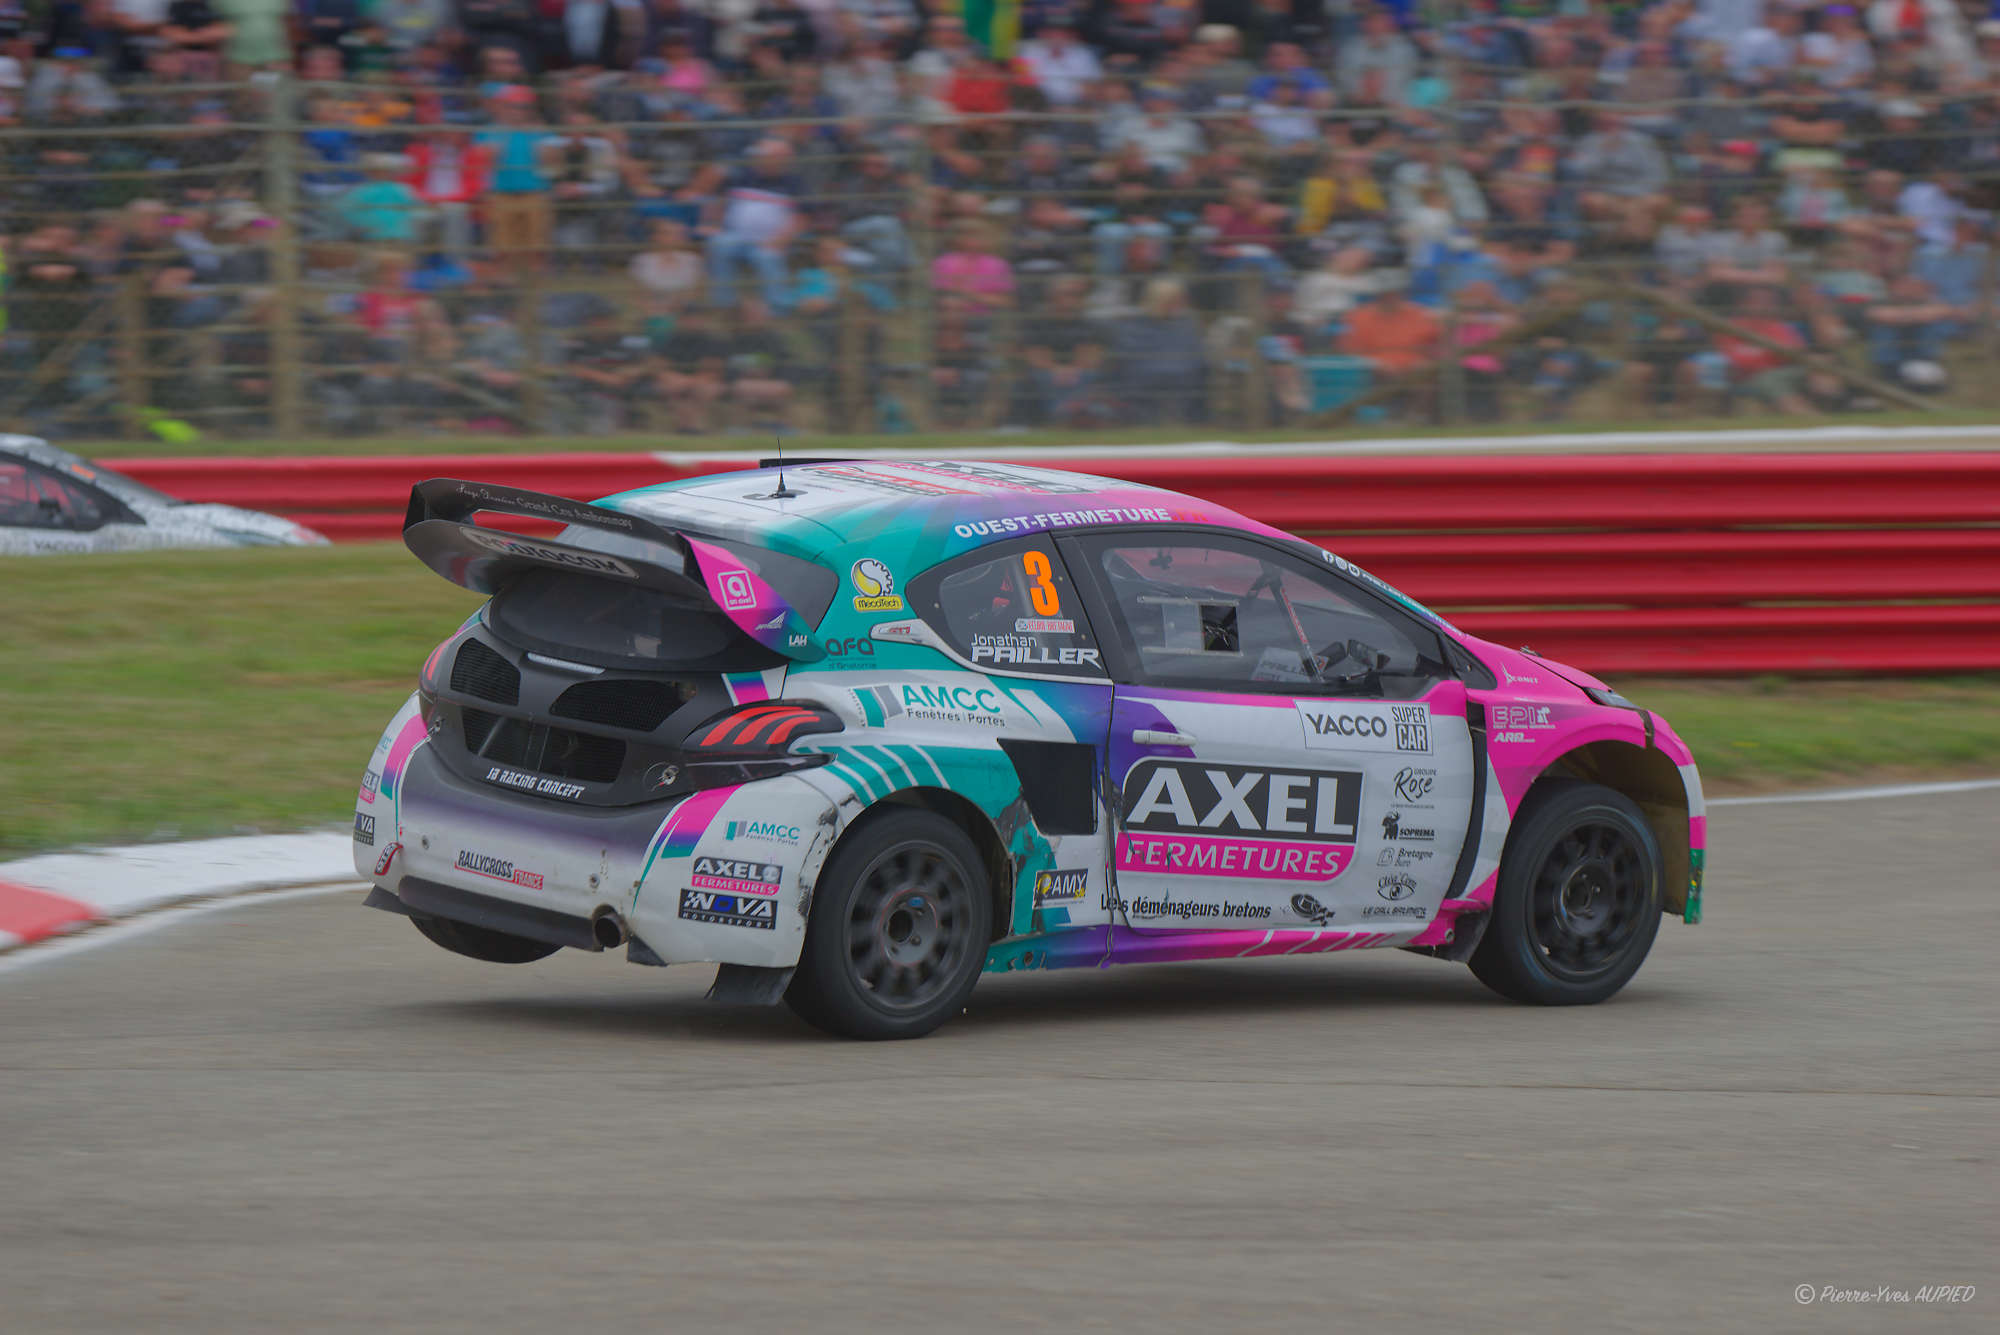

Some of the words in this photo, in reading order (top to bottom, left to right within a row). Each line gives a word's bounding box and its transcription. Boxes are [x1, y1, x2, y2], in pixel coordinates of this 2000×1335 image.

[1023, 550, 1060, 616] 3
[825, 637, 874, 656] afa
[971, 633, 1037, 648] Jonathan
[971, 647, 1102, 670] PAILLER
[902, 685, 1001, 714] AMCC
[968, 713, 1005, 727] Portes
[1306, 713, 1387, 738] YACCO
[1392, 706, 1426, 723] SUPER
[1396, 725, 1428, 751] CAR
[500, 770, 537, 790] RACING
[537, 779, 585, 799] CONCEPT
[1126, 767, 1355, 836] AXEL
[749, 821, 800, 840] AMCC
[458, 850, 513, 878] RALLYCROSS
[695, 858, 761, 880] AXEL
[1126, 841, 1339, 875] FERMETURES
[694, 876, 777, 894] FERMETURES
[1052, 873, 1087, 896] AMY
[1222, 900, 1271, 919] bretons
